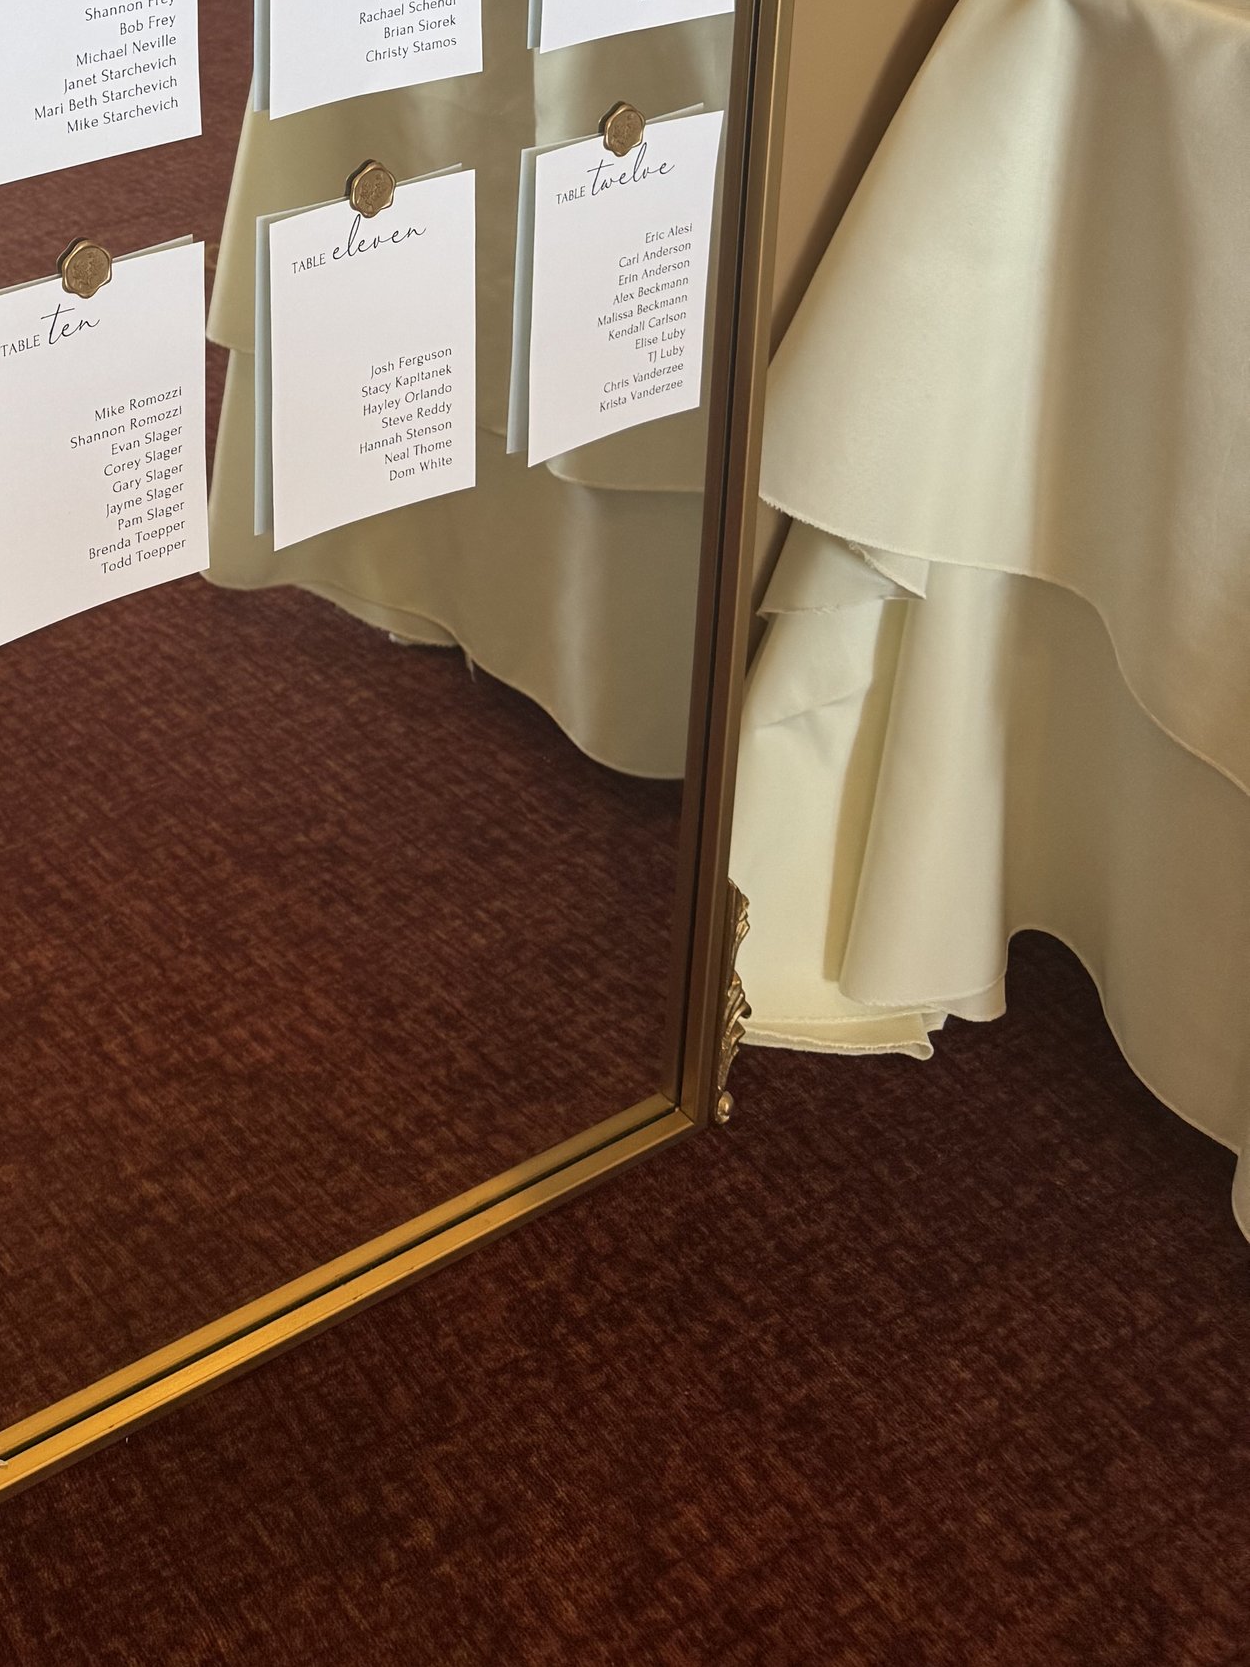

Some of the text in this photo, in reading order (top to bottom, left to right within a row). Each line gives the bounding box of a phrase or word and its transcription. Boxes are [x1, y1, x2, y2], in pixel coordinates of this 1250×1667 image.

[85, 1, 142, 21] Shannon
[384, 14, 456, 38] Brian Siorek
[77, 34, 176, 67] Michael Neville
[64, 54, 176, 94] Janet Starchevich
[35, 76, 177, 120] Mari Beth Starchevich
[556, 142, 675, 204] TABLE twelve
[292, 213, 427, 275] TABLE eleven
[613, 277, 688, 305] Alex Beckmann
[0, 303, 100, 357] TABLE ten
[609, 312, 686, 341] Kendall Carlson
[635, 328, 685, 349] Elise Luby
[371, 348, 451, 379] Josh Ferguson
[648, 345, 684, 363] TJ Luby
[364, 383, 452, 416] Hayley Orlando
[382, 401, 452, 428] Steve Reddy
[360, 421, 452, 454] Hannah Stenson
[104, 445, 182, 476] Corey Slager
[390, 457, 452, 481] Dom White
[106, 483, 184, 518] Jayme Slager
[118, 502, 185, 530] Pam Slager
[89, 521, 185, 559] Brenda Toepper
[101, 539, 186, 574] Todd Toepper
